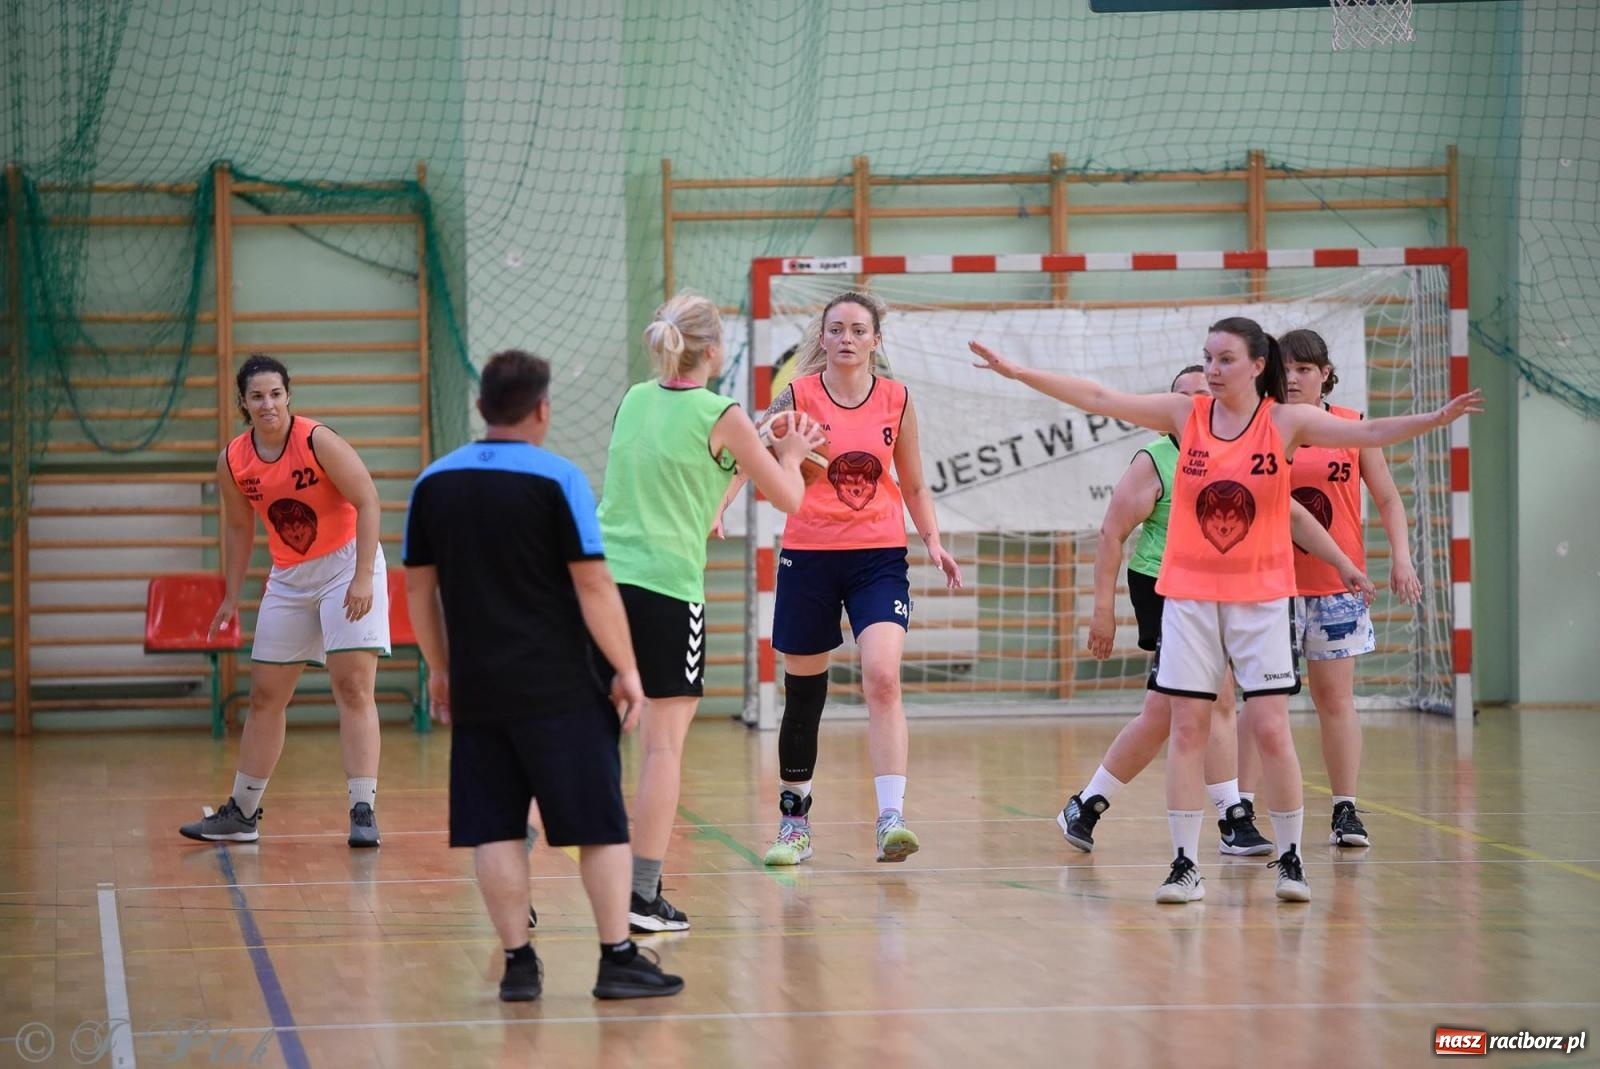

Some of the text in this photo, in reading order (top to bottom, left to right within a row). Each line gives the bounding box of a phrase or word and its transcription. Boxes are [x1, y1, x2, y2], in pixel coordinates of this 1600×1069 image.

[882, 427, 893, 446] 8
[930, 435, 1026, 494] JEST
[1034, 419, 1074, 457] W
[1250, 452, 1279, 476] 23
[291, 466, 319, 491] 22
[1327, 461, 1352, 483] 25
[893, 599, 909, 619] 24
